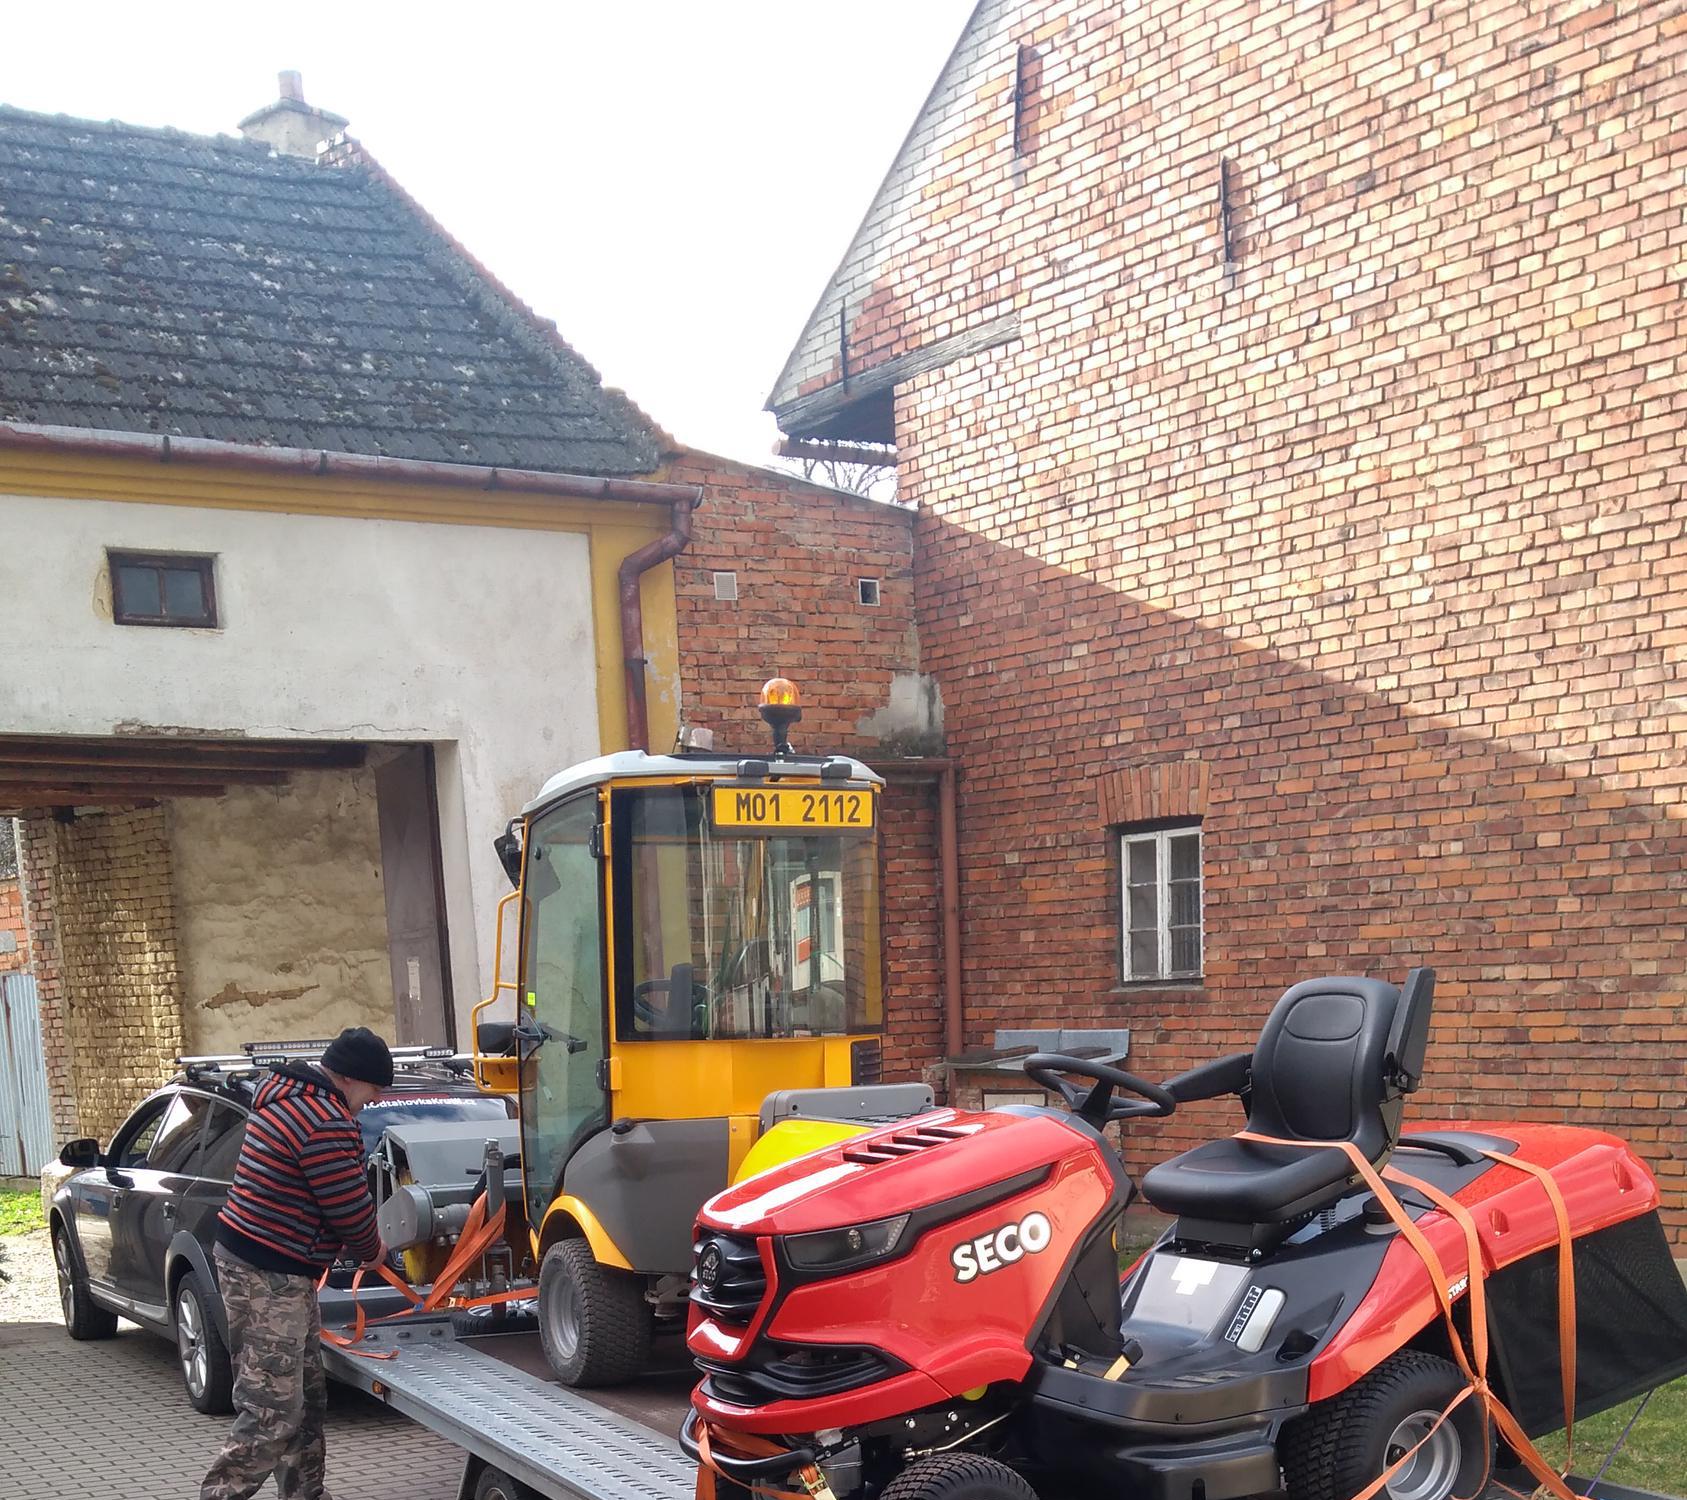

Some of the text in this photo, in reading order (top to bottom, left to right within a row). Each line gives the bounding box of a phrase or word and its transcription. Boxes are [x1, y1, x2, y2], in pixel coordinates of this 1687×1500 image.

[736, 793, 861, 823] M01 2112
[951, 1212, 1051, 1282] SECO
